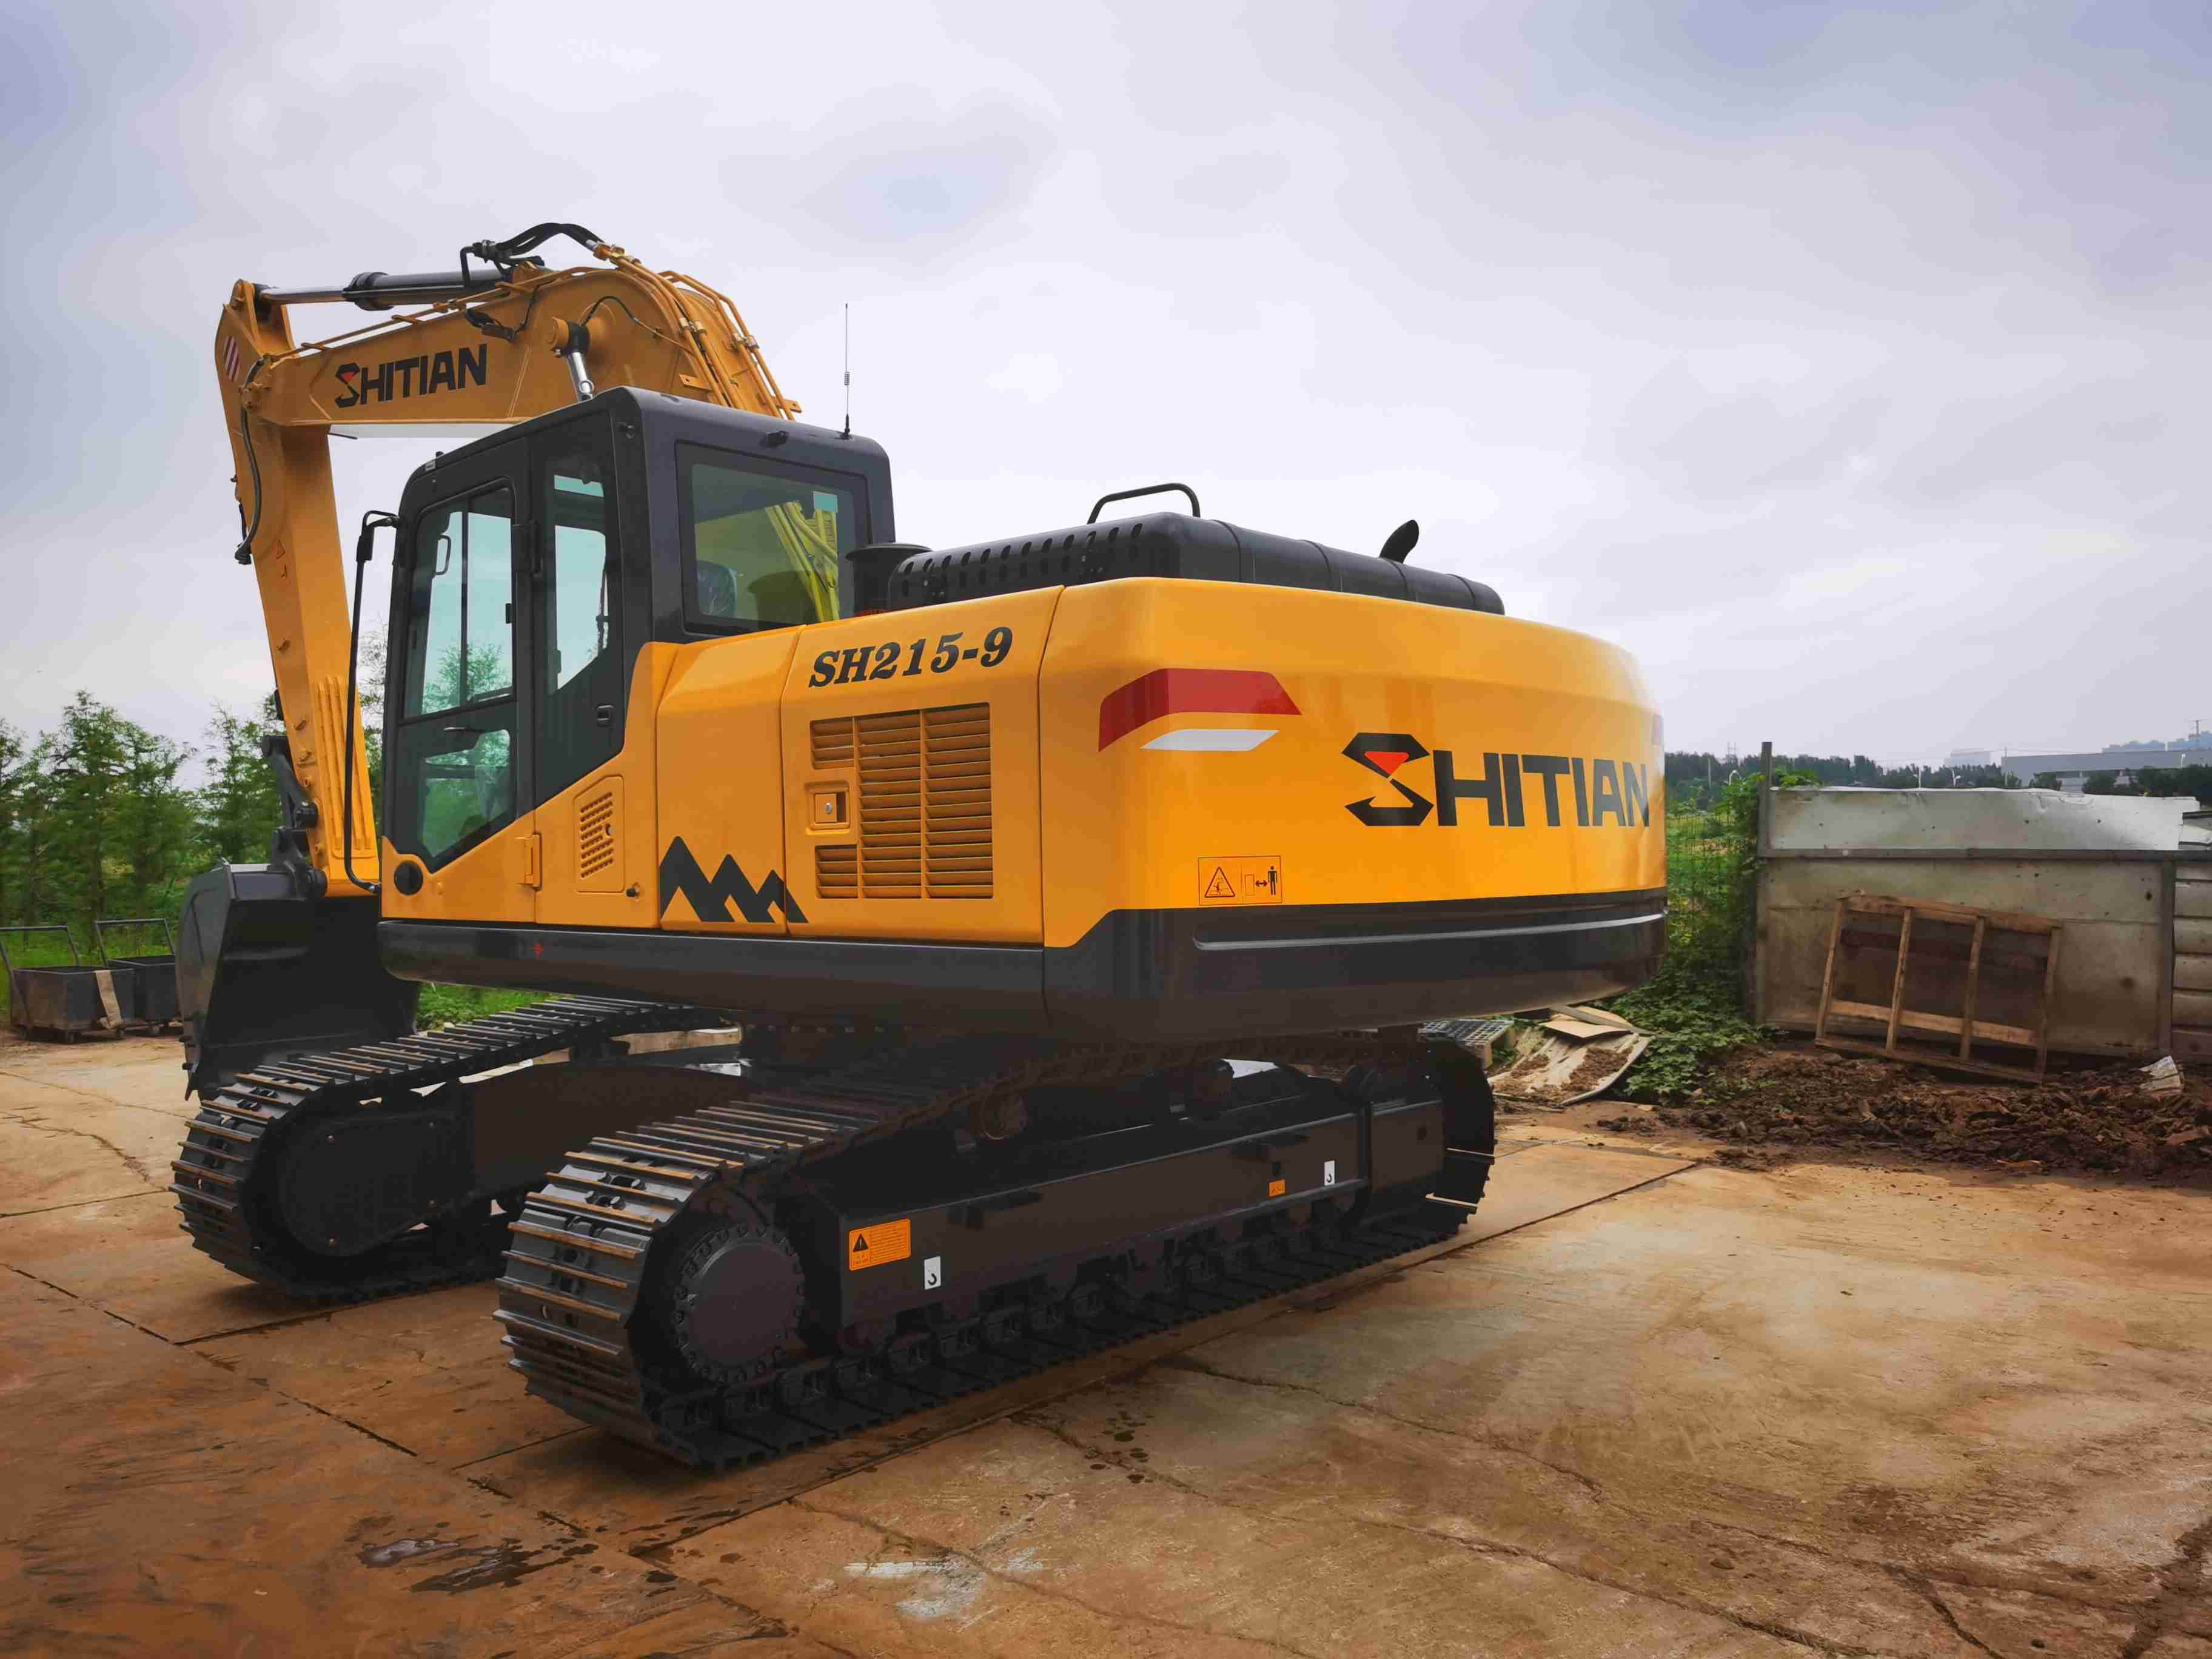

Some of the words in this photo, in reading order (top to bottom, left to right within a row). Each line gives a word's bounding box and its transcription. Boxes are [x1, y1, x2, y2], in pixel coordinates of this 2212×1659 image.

[335, 344, 488, 408] SHITIAN
[808, 626, 1013, 688] SH215-9
[1341, 732, 1650, 827] SHITIAN
